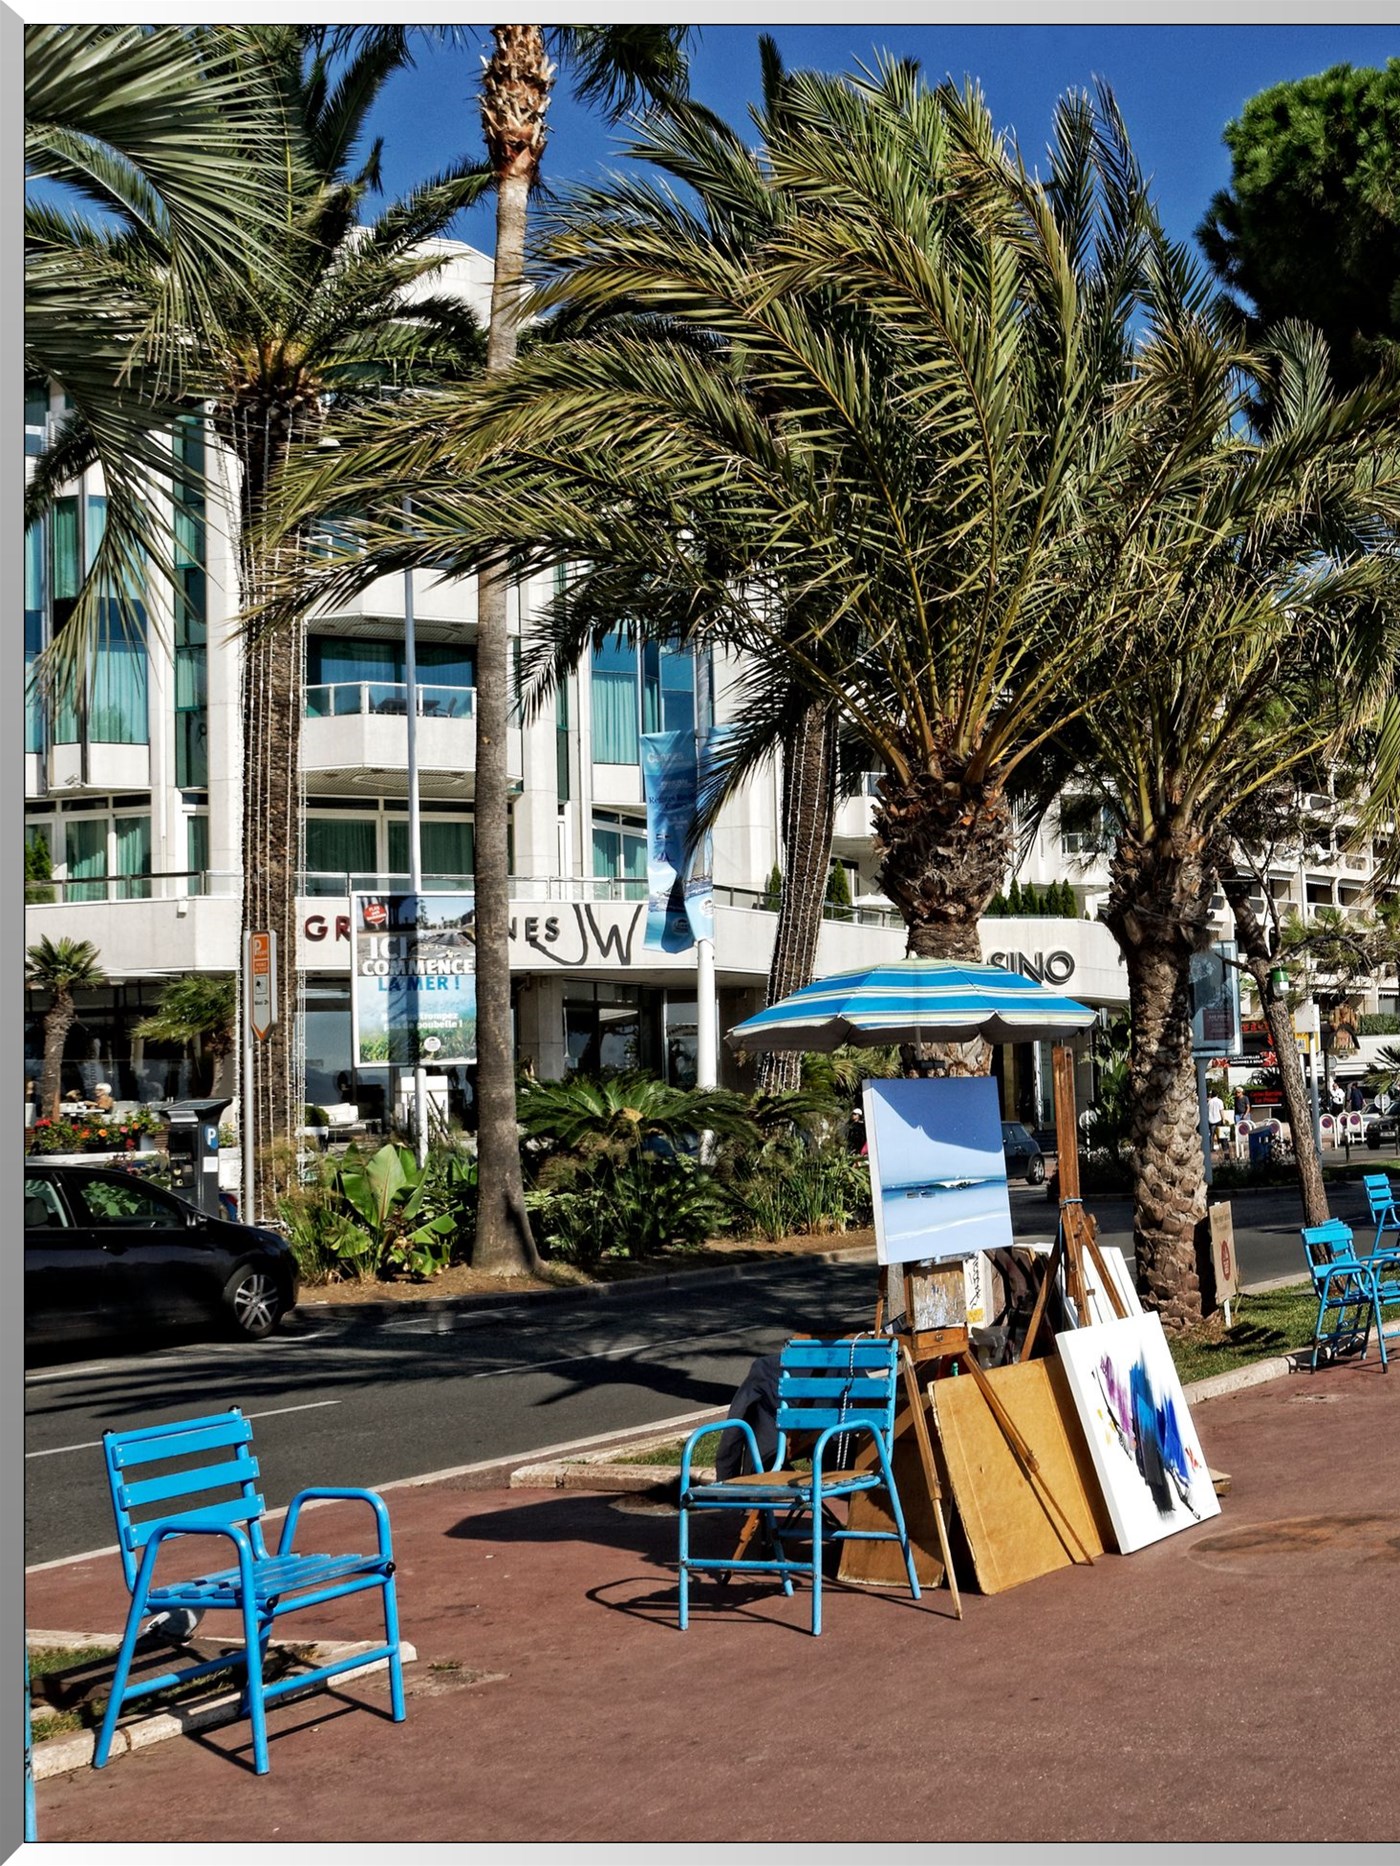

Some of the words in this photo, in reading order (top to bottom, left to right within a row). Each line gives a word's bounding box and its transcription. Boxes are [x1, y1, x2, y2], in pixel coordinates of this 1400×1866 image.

[529, 903, 644, 966] JW
[369, 936, 408, 959] ICI
[362, 959, 476, 976] COMMENCE
[378, 976, 401, 992] LA
[406, 976, 449, 991] MER
